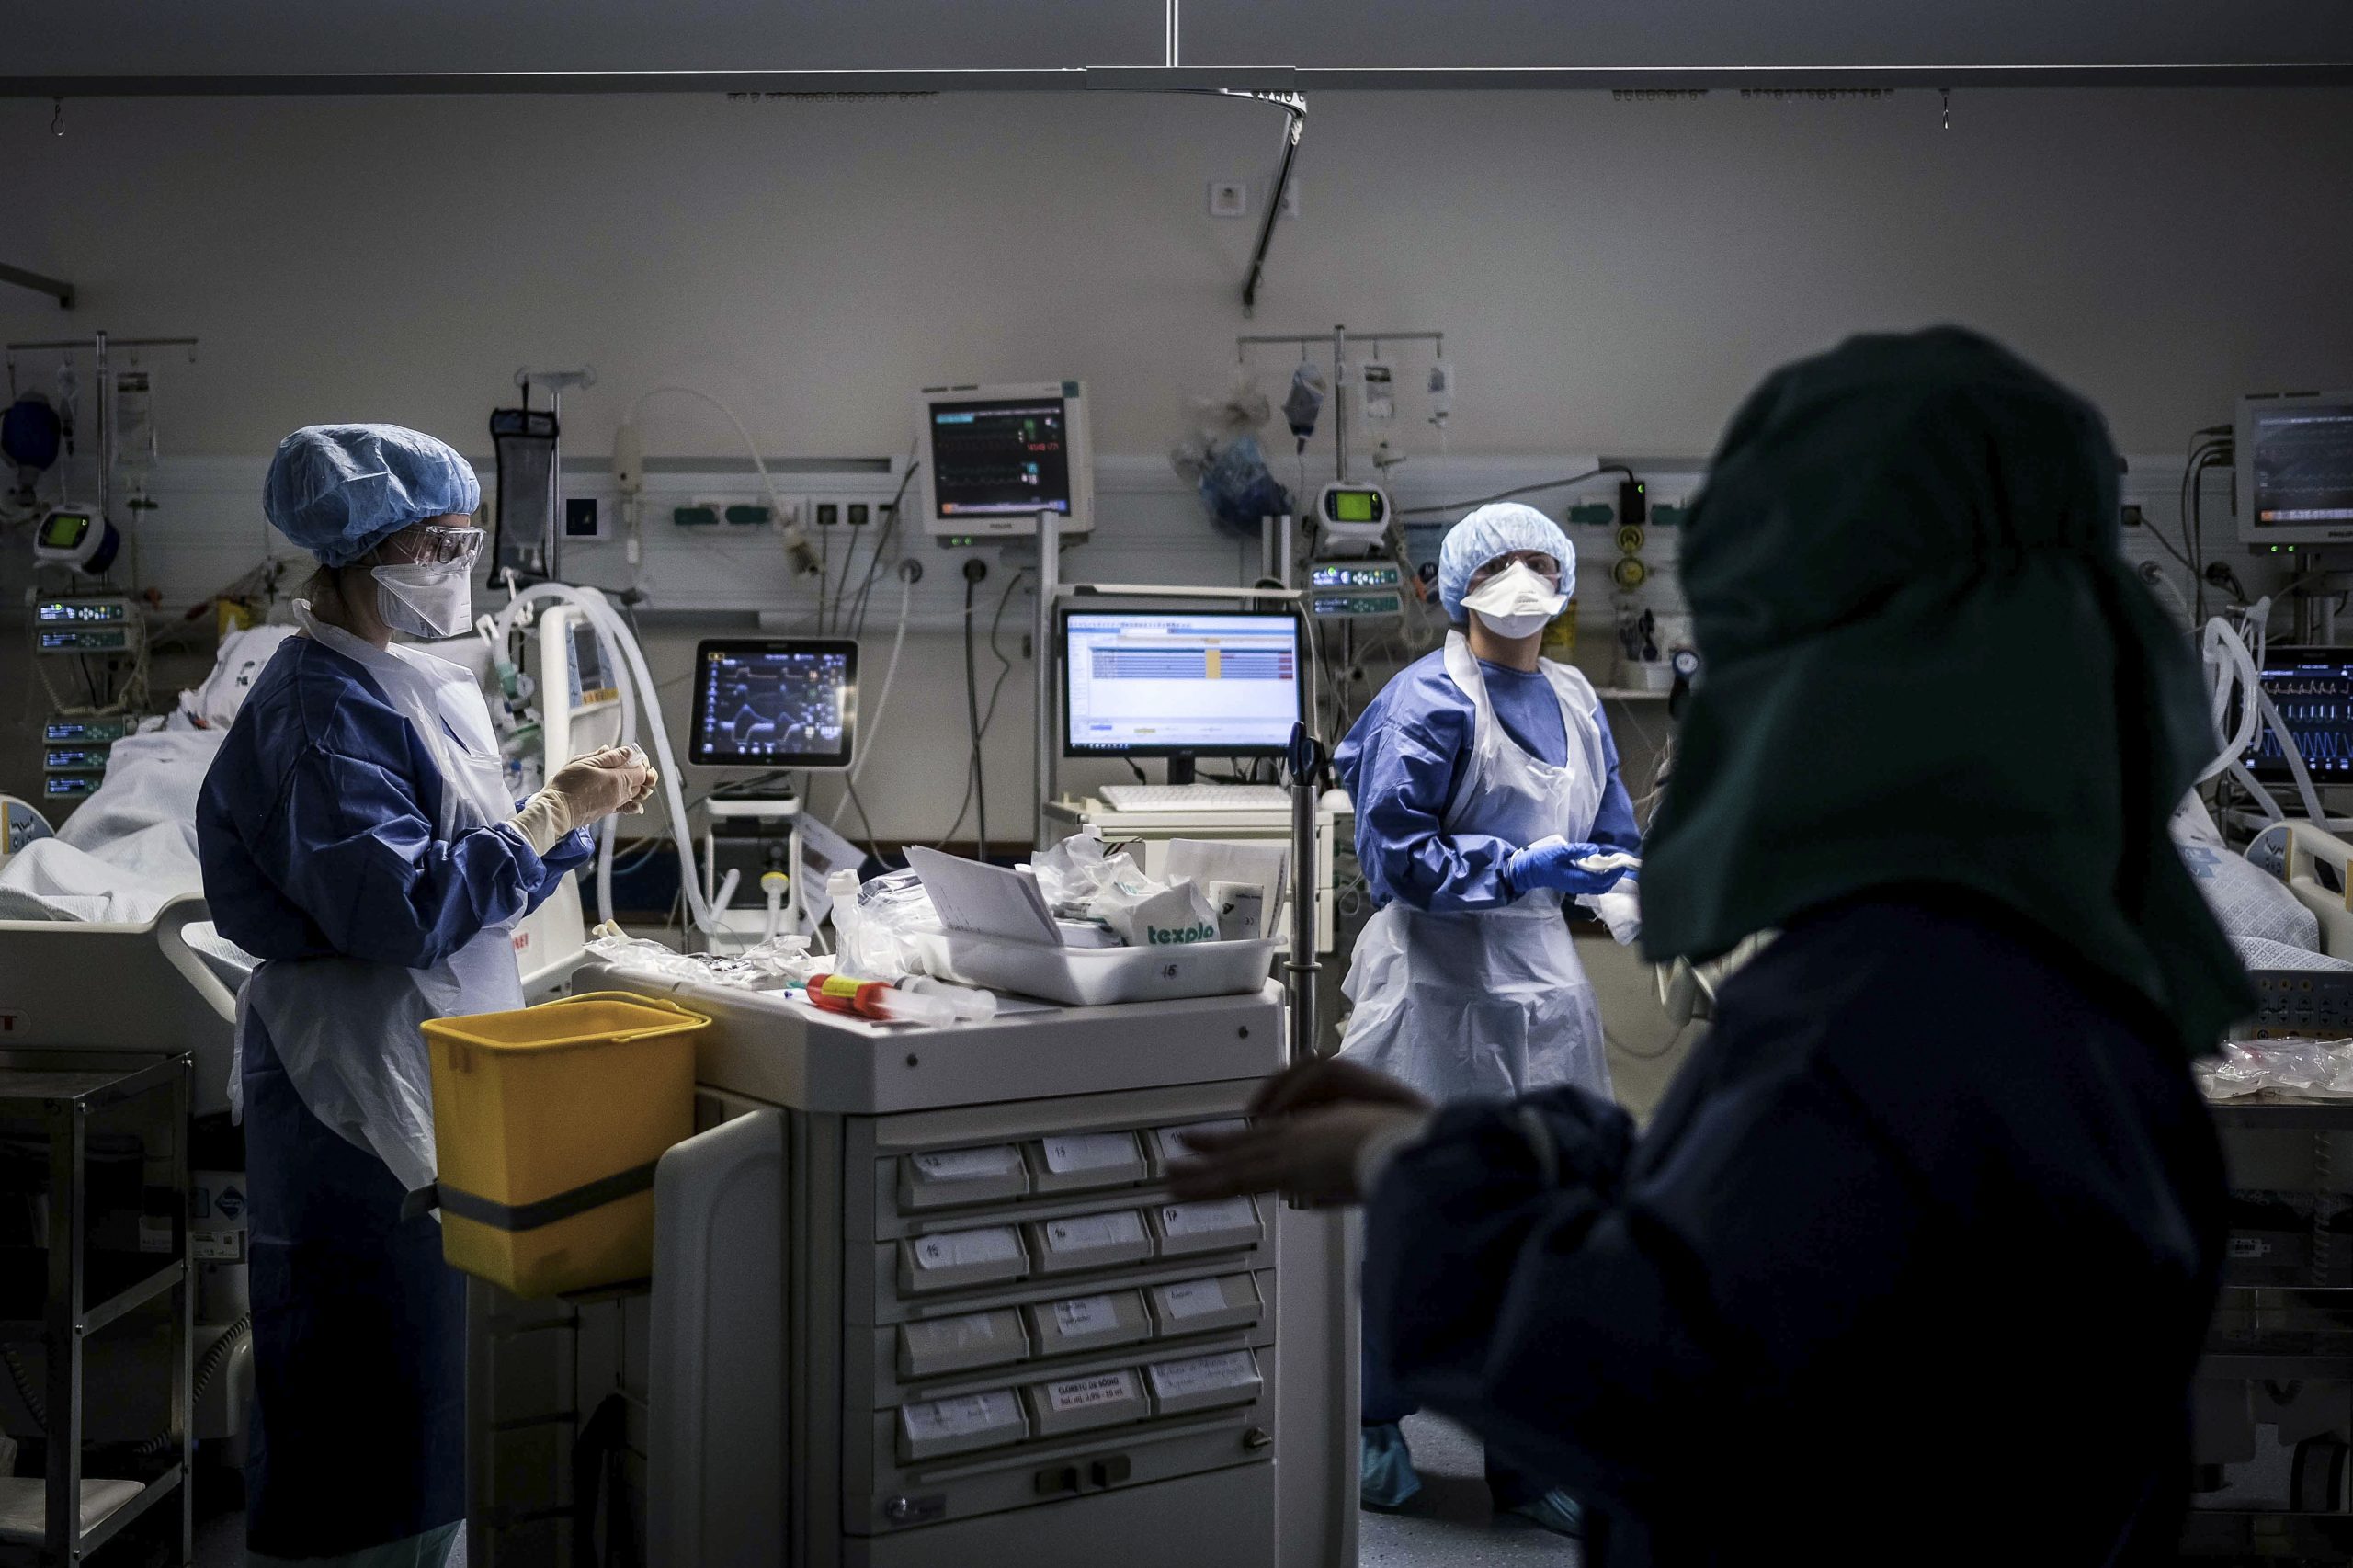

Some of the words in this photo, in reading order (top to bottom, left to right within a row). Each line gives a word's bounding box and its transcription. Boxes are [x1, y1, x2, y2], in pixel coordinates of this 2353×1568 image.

[1147, 922, 1214, 944] texplo
[1054, 1145, 1066, 1158] 13
[1165, 1209, 1177, 1222] 17
[926, 1244, 939, 1257] 15
